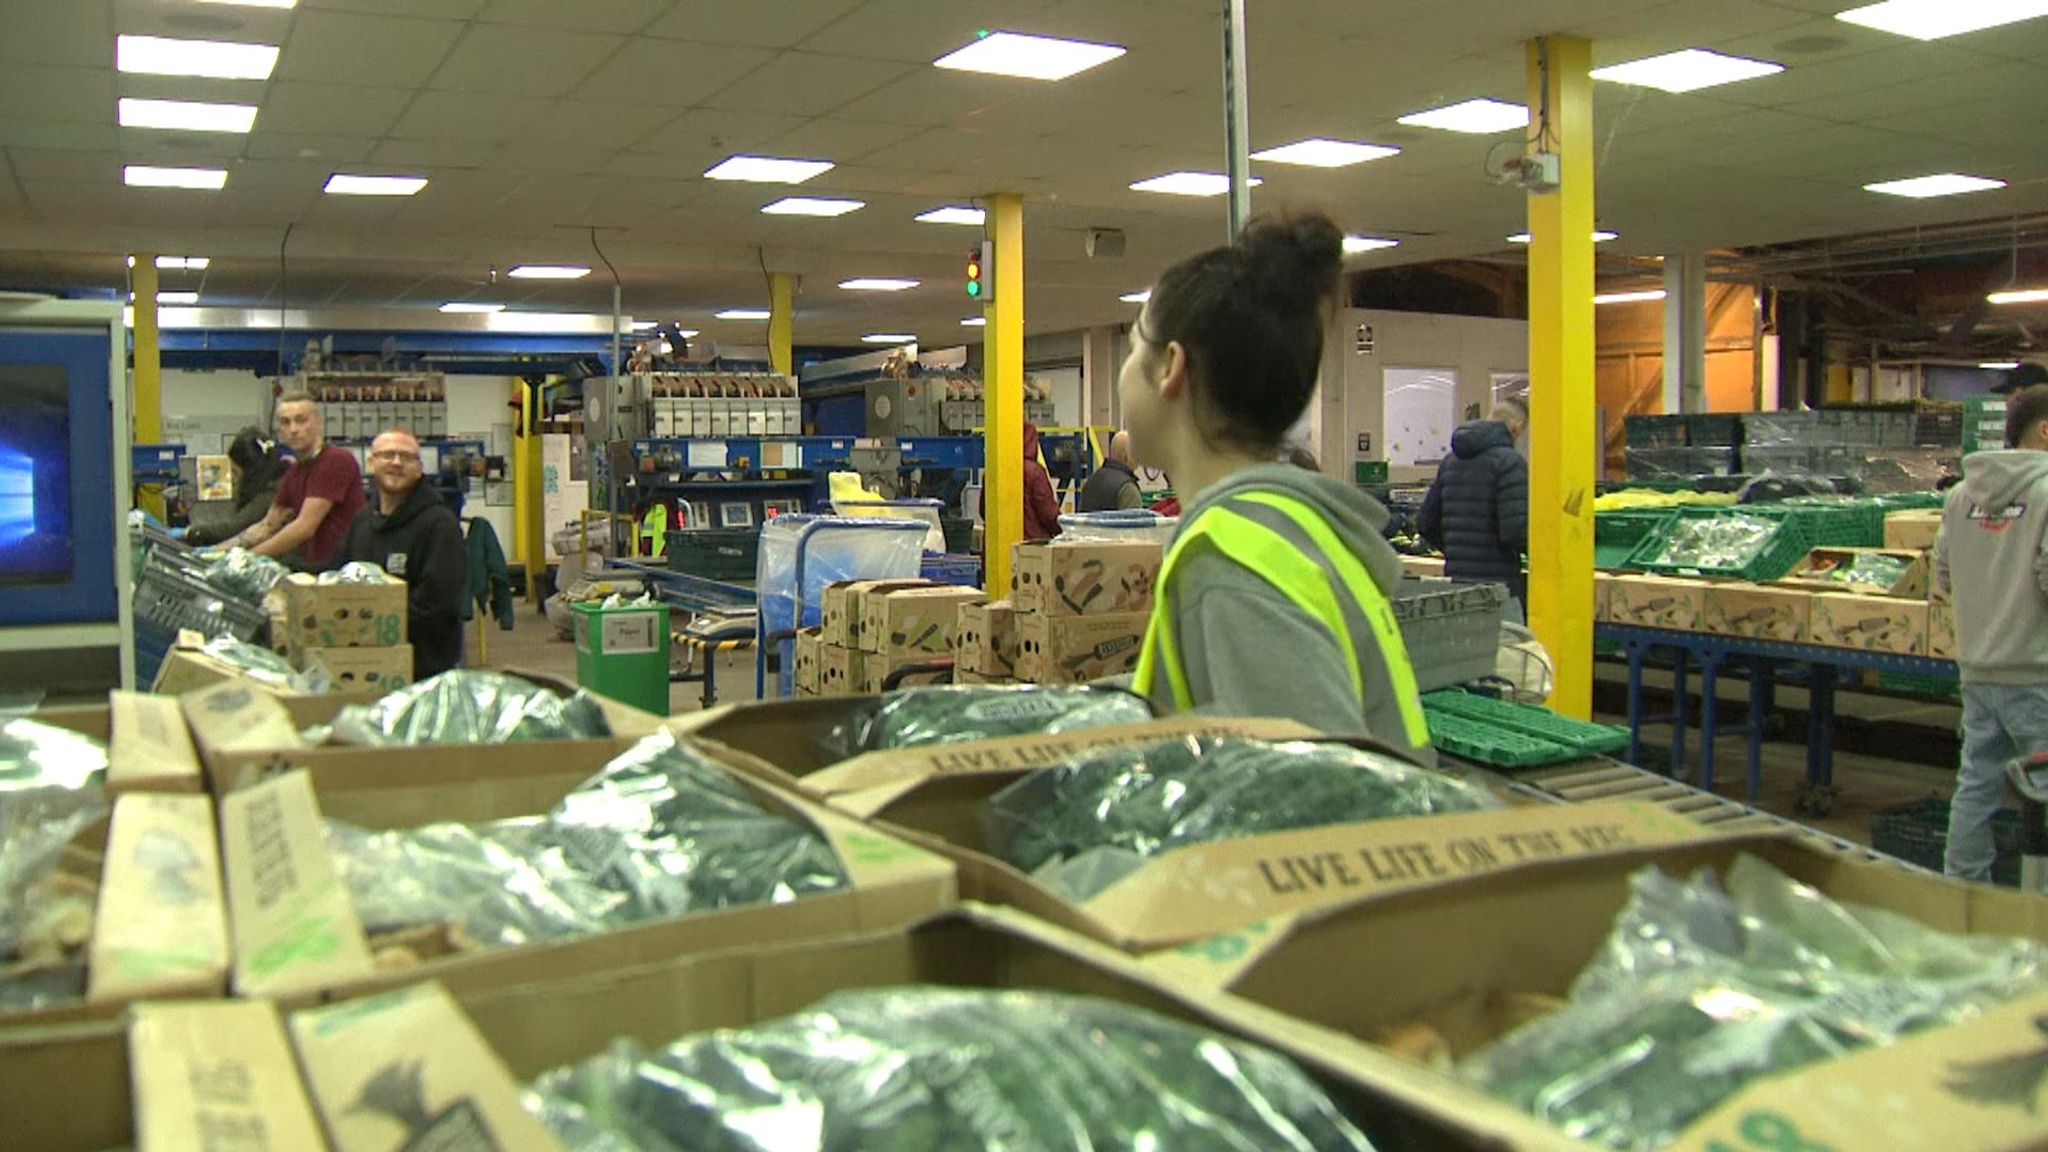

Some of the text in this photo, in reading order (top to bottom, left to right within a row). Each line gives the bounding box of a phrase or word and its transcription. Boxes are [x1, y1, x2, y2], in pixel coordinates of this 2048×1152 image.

[376, 613, 400, 646] 18
[1257, 852, 1361, 893] LIVE
[1359, 843, 1447, 881] LIFE
[1446, 838, 1497, 869] ON
